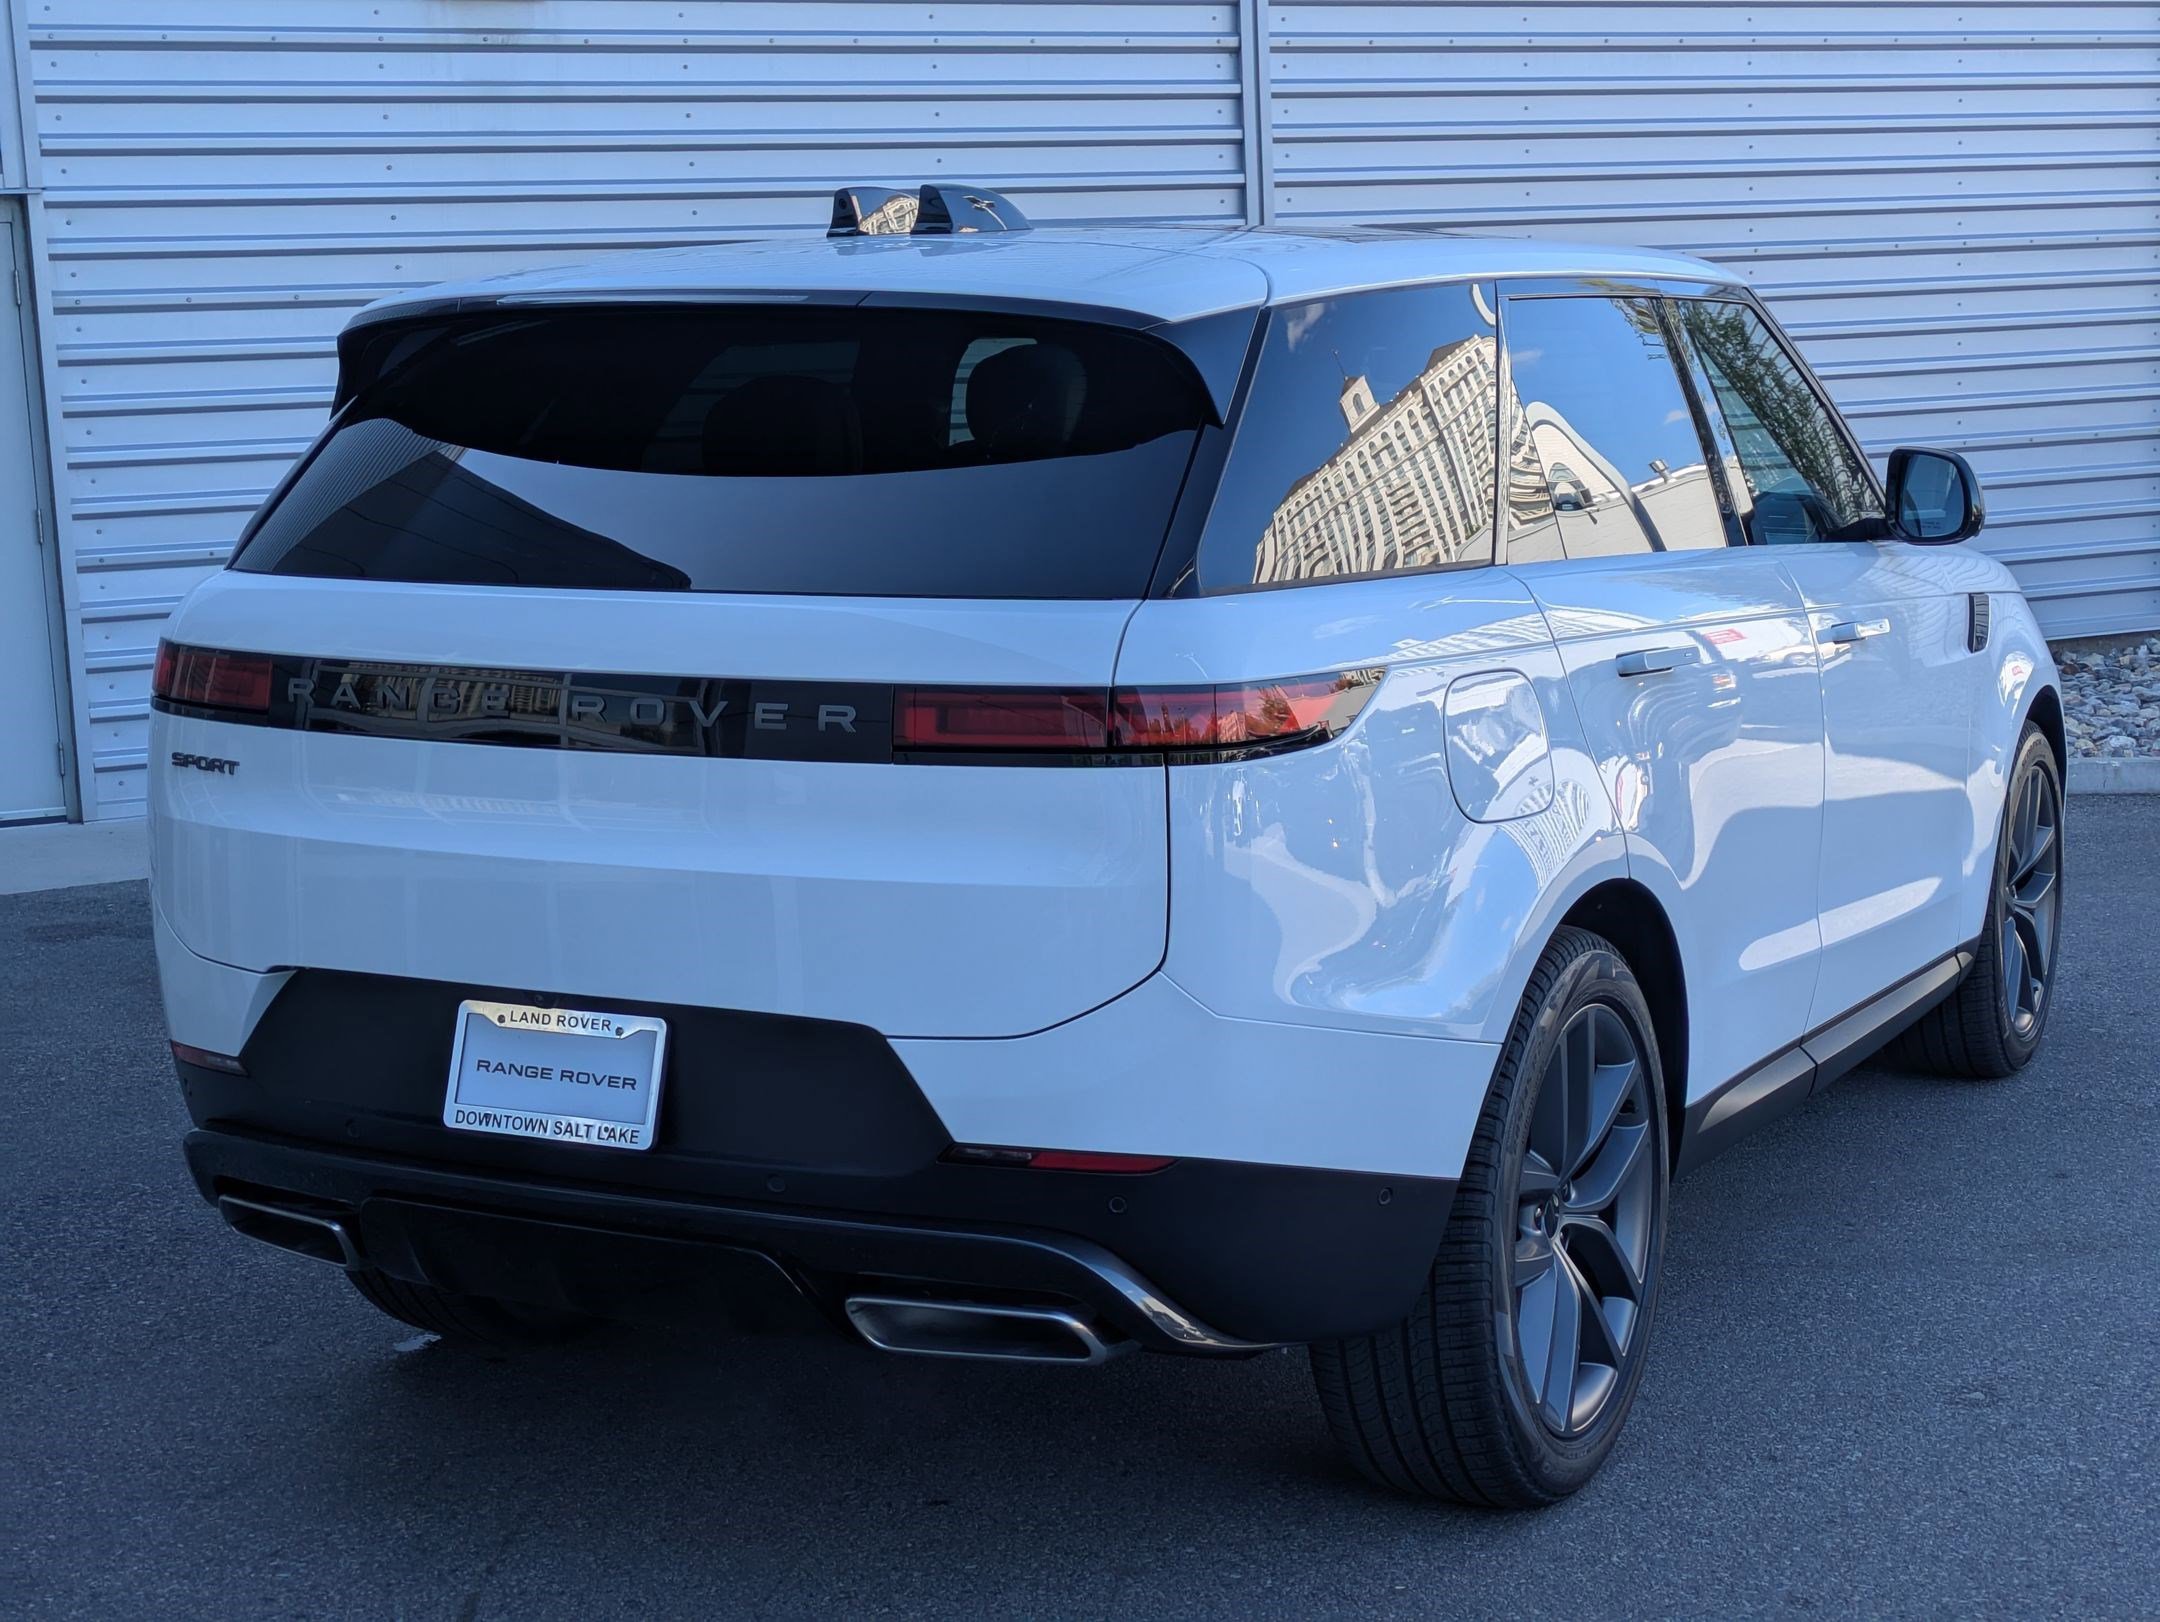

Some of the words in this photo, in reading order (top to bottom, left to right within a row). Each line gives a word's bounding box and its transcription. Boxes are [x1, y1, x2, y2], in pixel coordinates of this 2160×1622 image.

[288, 678, 511, 718] RANGE
[571, 695, 857, 733] ROVER
[171, 752, 240, 775] SPORT
[510, 1010, 551, 1026] LAND
[556, 1016, 611, 1032] ROVER
[476, 1059, 554, 1080] RANGE
[560, 1069, 637, 1090] ROVER
[455, 1110, 549, 1134] DOWNTOWN
[553, 1120, 593, 1138] SALT
[597, 1125, 640, 1144] LAKE
